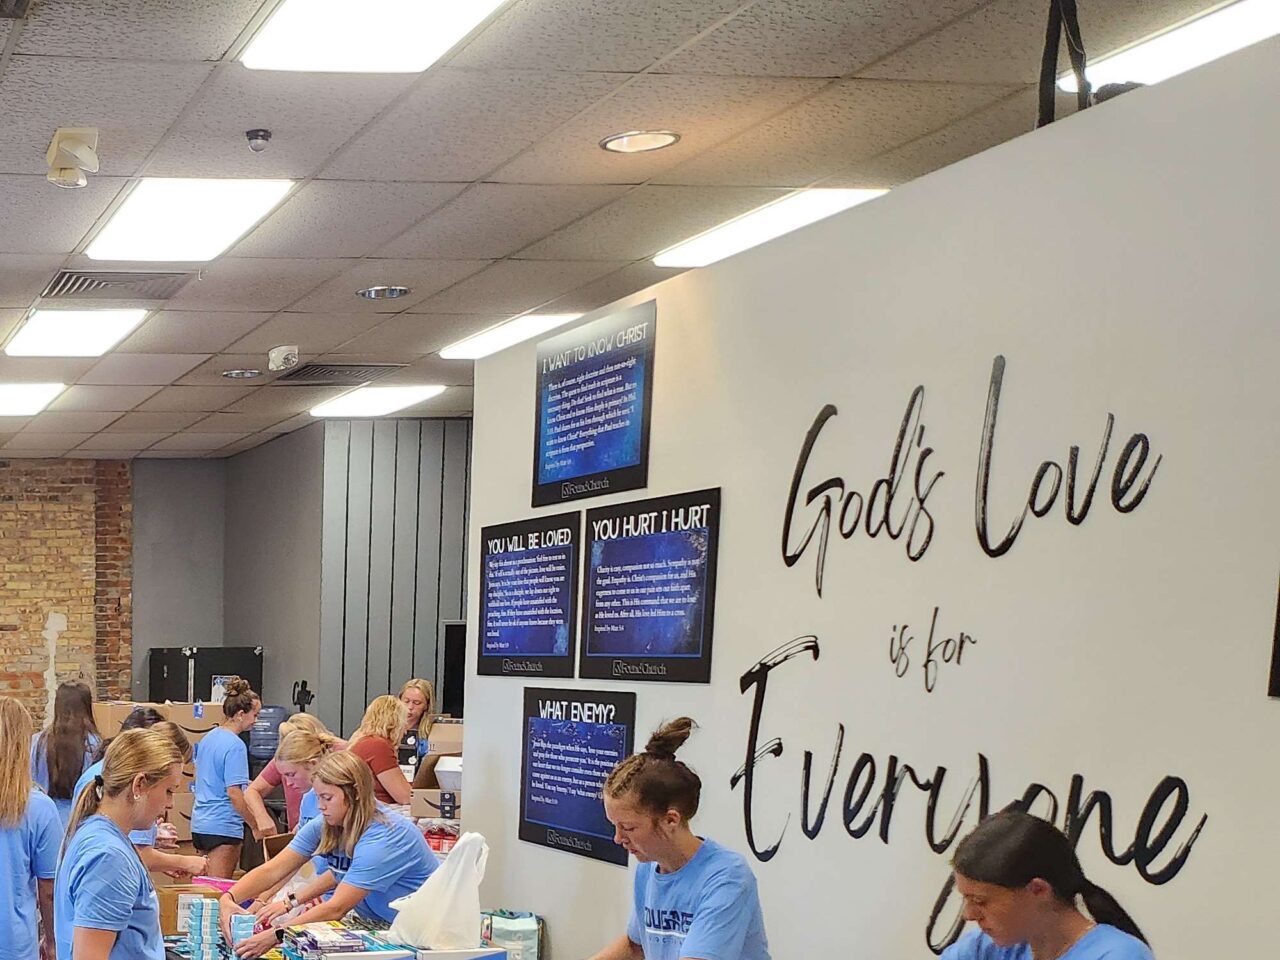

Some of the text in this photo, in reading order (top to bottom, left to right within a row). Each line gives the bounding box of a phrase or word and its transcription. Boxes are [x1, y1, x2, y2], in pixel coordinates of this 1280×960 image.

[548, 350, 571, 372] WANT
[574, 346, 586, 362] TO
[587, 336, 613, 358] KNOW
[616, 322, 648, 348] CHRIST
[781, 385, 945, 598] God's
[975, 355, 1163, 558] Love
[487, 528, 571, 554] YOU WILL BE LOVED
[592, 504, 711, 541] YOU HURT I HURT
[889, 606, 976, 693] is for
[539, 699, 616, 725] WHAT ENEMY?
[731, 635, 1208, 955] Everyone
[644, 906, 694, 933] OUGAR
